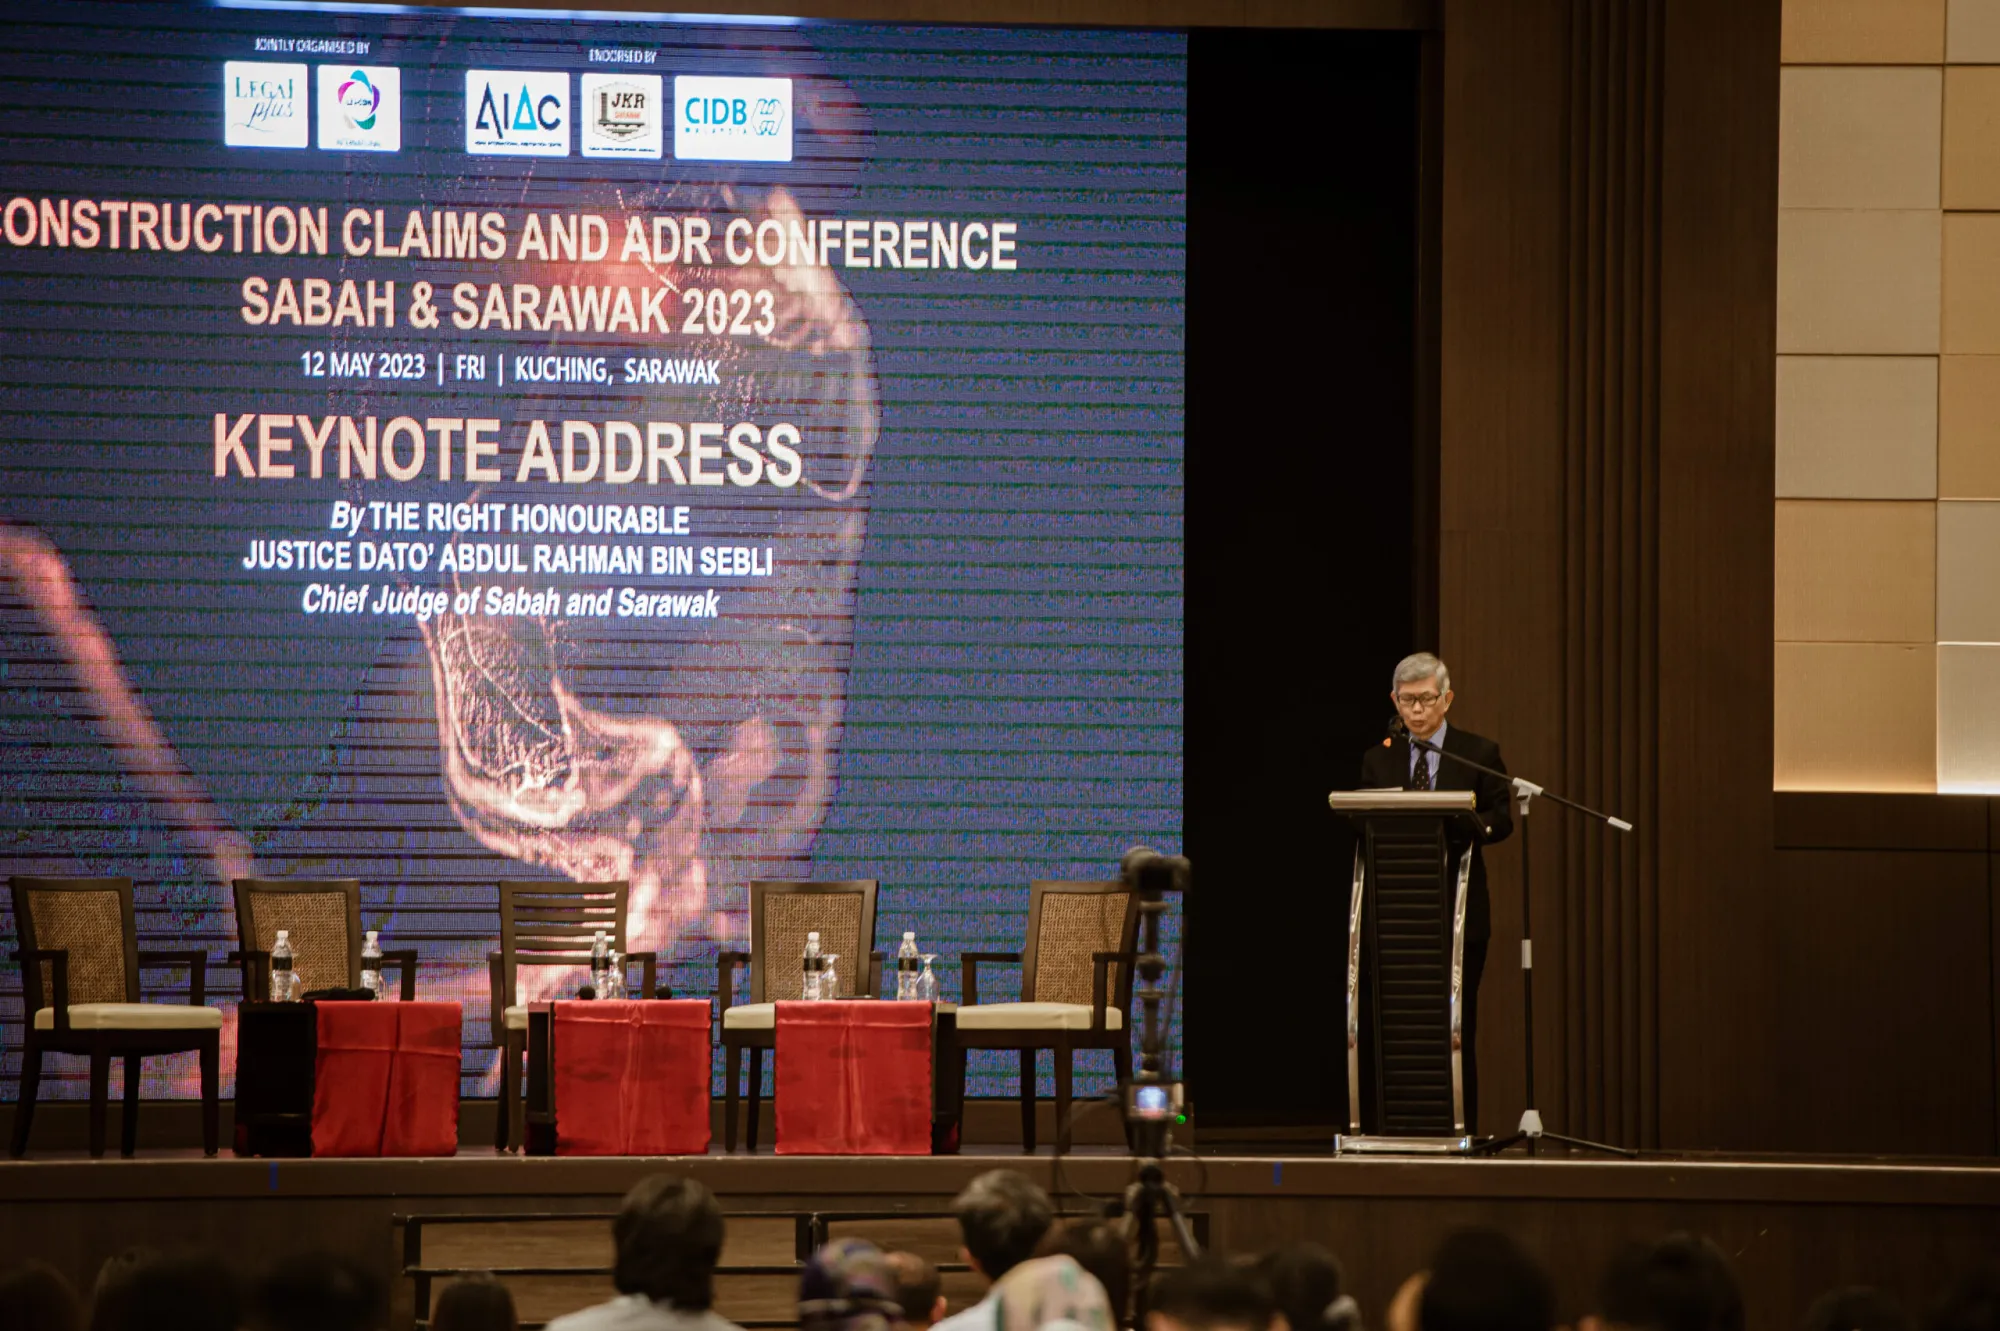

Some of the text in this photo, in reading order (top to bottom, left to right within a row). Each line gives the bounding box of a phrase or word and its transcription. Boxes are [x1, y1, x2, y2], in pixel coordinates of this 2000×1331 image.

[254, 37, 295, 52] JOINTLY
[356, 41, 371, 54] BY
[644, 50, 657, 64] BY
[235, 76, 293, 99] LEGAL
[611, 92, 645, 109] JKR
[246, 101, 293, 128] plus
[475, 81, 561, 140] AIAC
[685, 96, 747, 125] CIDB
[0, 197, 1018, 270] ONSTRUCTION CLAIMS AND ADR CONFERENCE
[241, 277, 777, 336] SABAH & SARAWAK 2023
[301, 350, 325, 376] 12
[330, 351, 375, 378] MAY
[378, 352, 426, 379] 2023
[456, 354, 487, 380] FRI
[515, 355, 612, 385] KUCHING,
[624, 357, 721, 385] SARAWAK
[214, 413, 803, 488] KEYNOTE ADDRESS
[330, 500, 690, 537] By THE RIGHT HONOURABLE
[242, 539, 352, 571] JUSTICE
[438, 543, 528, 573] ABDUL
[533, 544, 644, 574] RAHMAN
[651, 545, 693, 576] BIN
[700, 546, 774, 577] SEBLI
[302, 583, 721, 619] Chief Judge of Sabah and Sarawak
